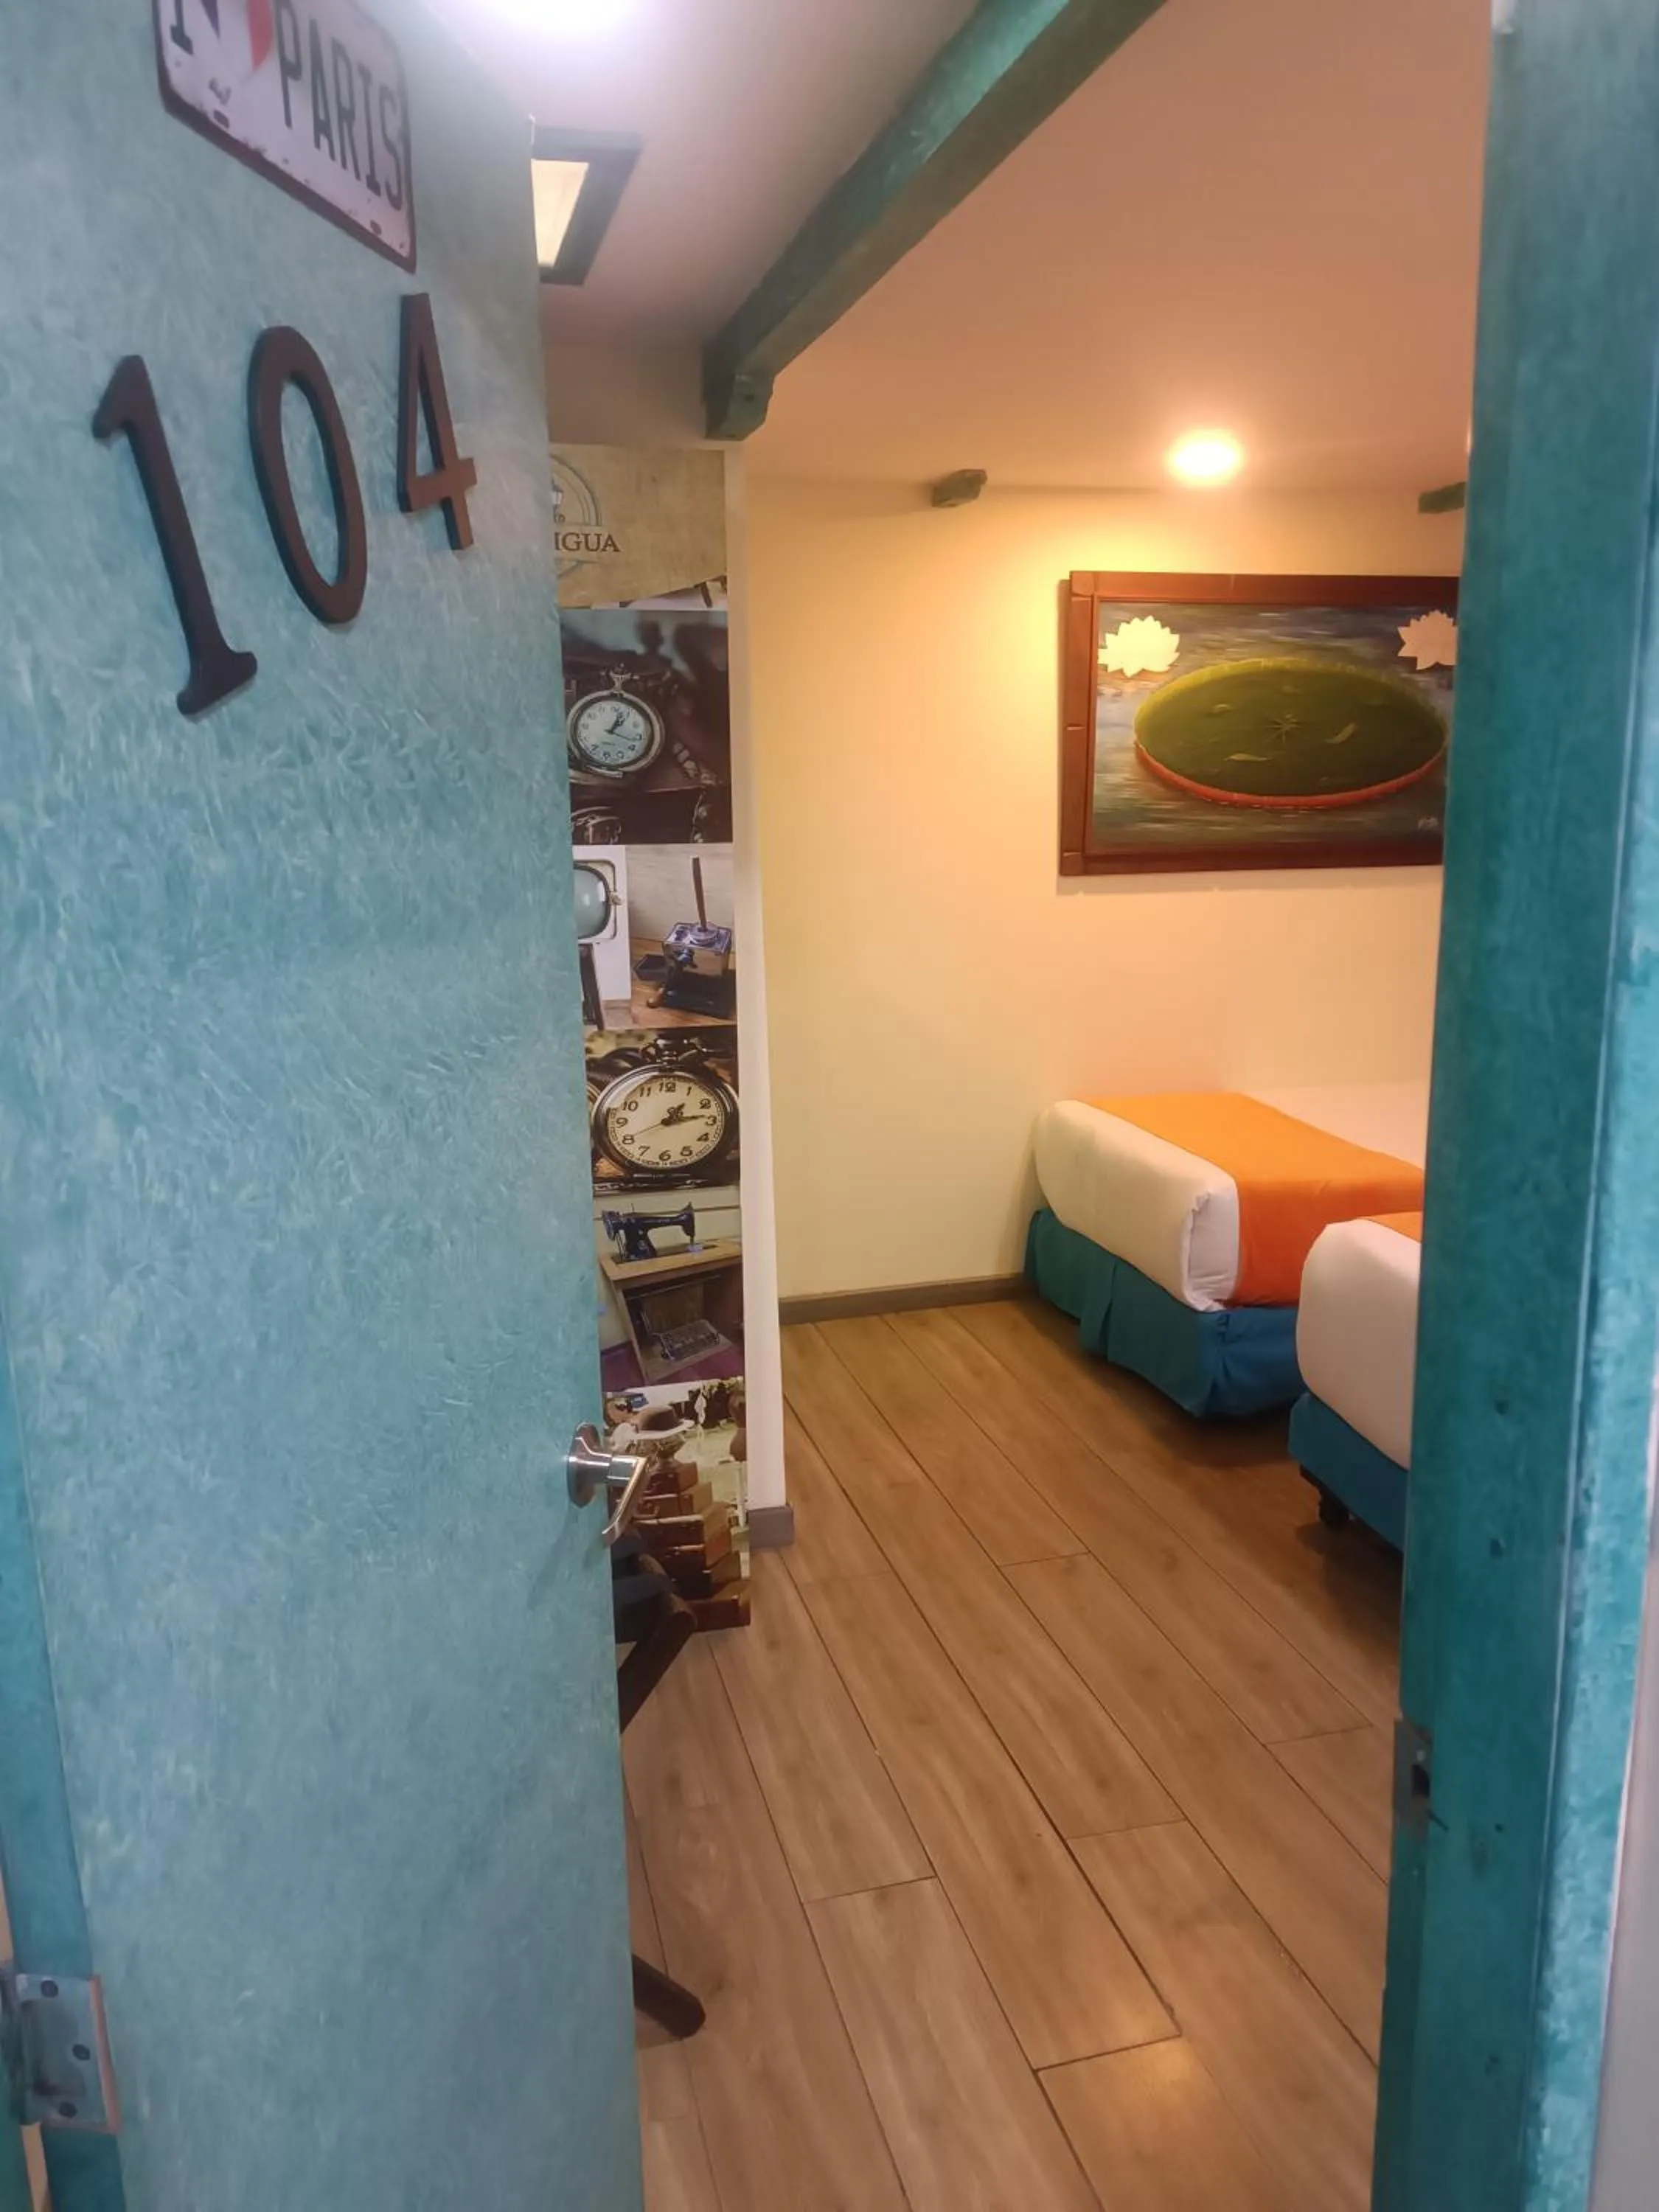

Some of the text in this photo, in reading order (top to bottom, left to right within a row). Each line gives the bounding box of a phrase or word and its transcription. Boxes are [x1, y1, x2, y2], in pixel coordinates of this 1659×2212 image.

[273, 0, 405, 211] PARIS
[92, 292, 478, 714] 104
[640, 1086, 652, 1097] 11
[658, 1082, 676, 1093] 12
[686, 1086, 692, 1096] 1
[622, 1100, 639, 1112] 10
[616, 1117, 628, 1128] 9
[706, 1115, 717, 1126] 3
[622, 1134, 635, 1145] 8
[696, 1132, 709, 1142] 4
[638, 1145, 650, 1157] 7
[658, 1150, 671, 1161] 6
[680, 1145, 693, 1157] 5
